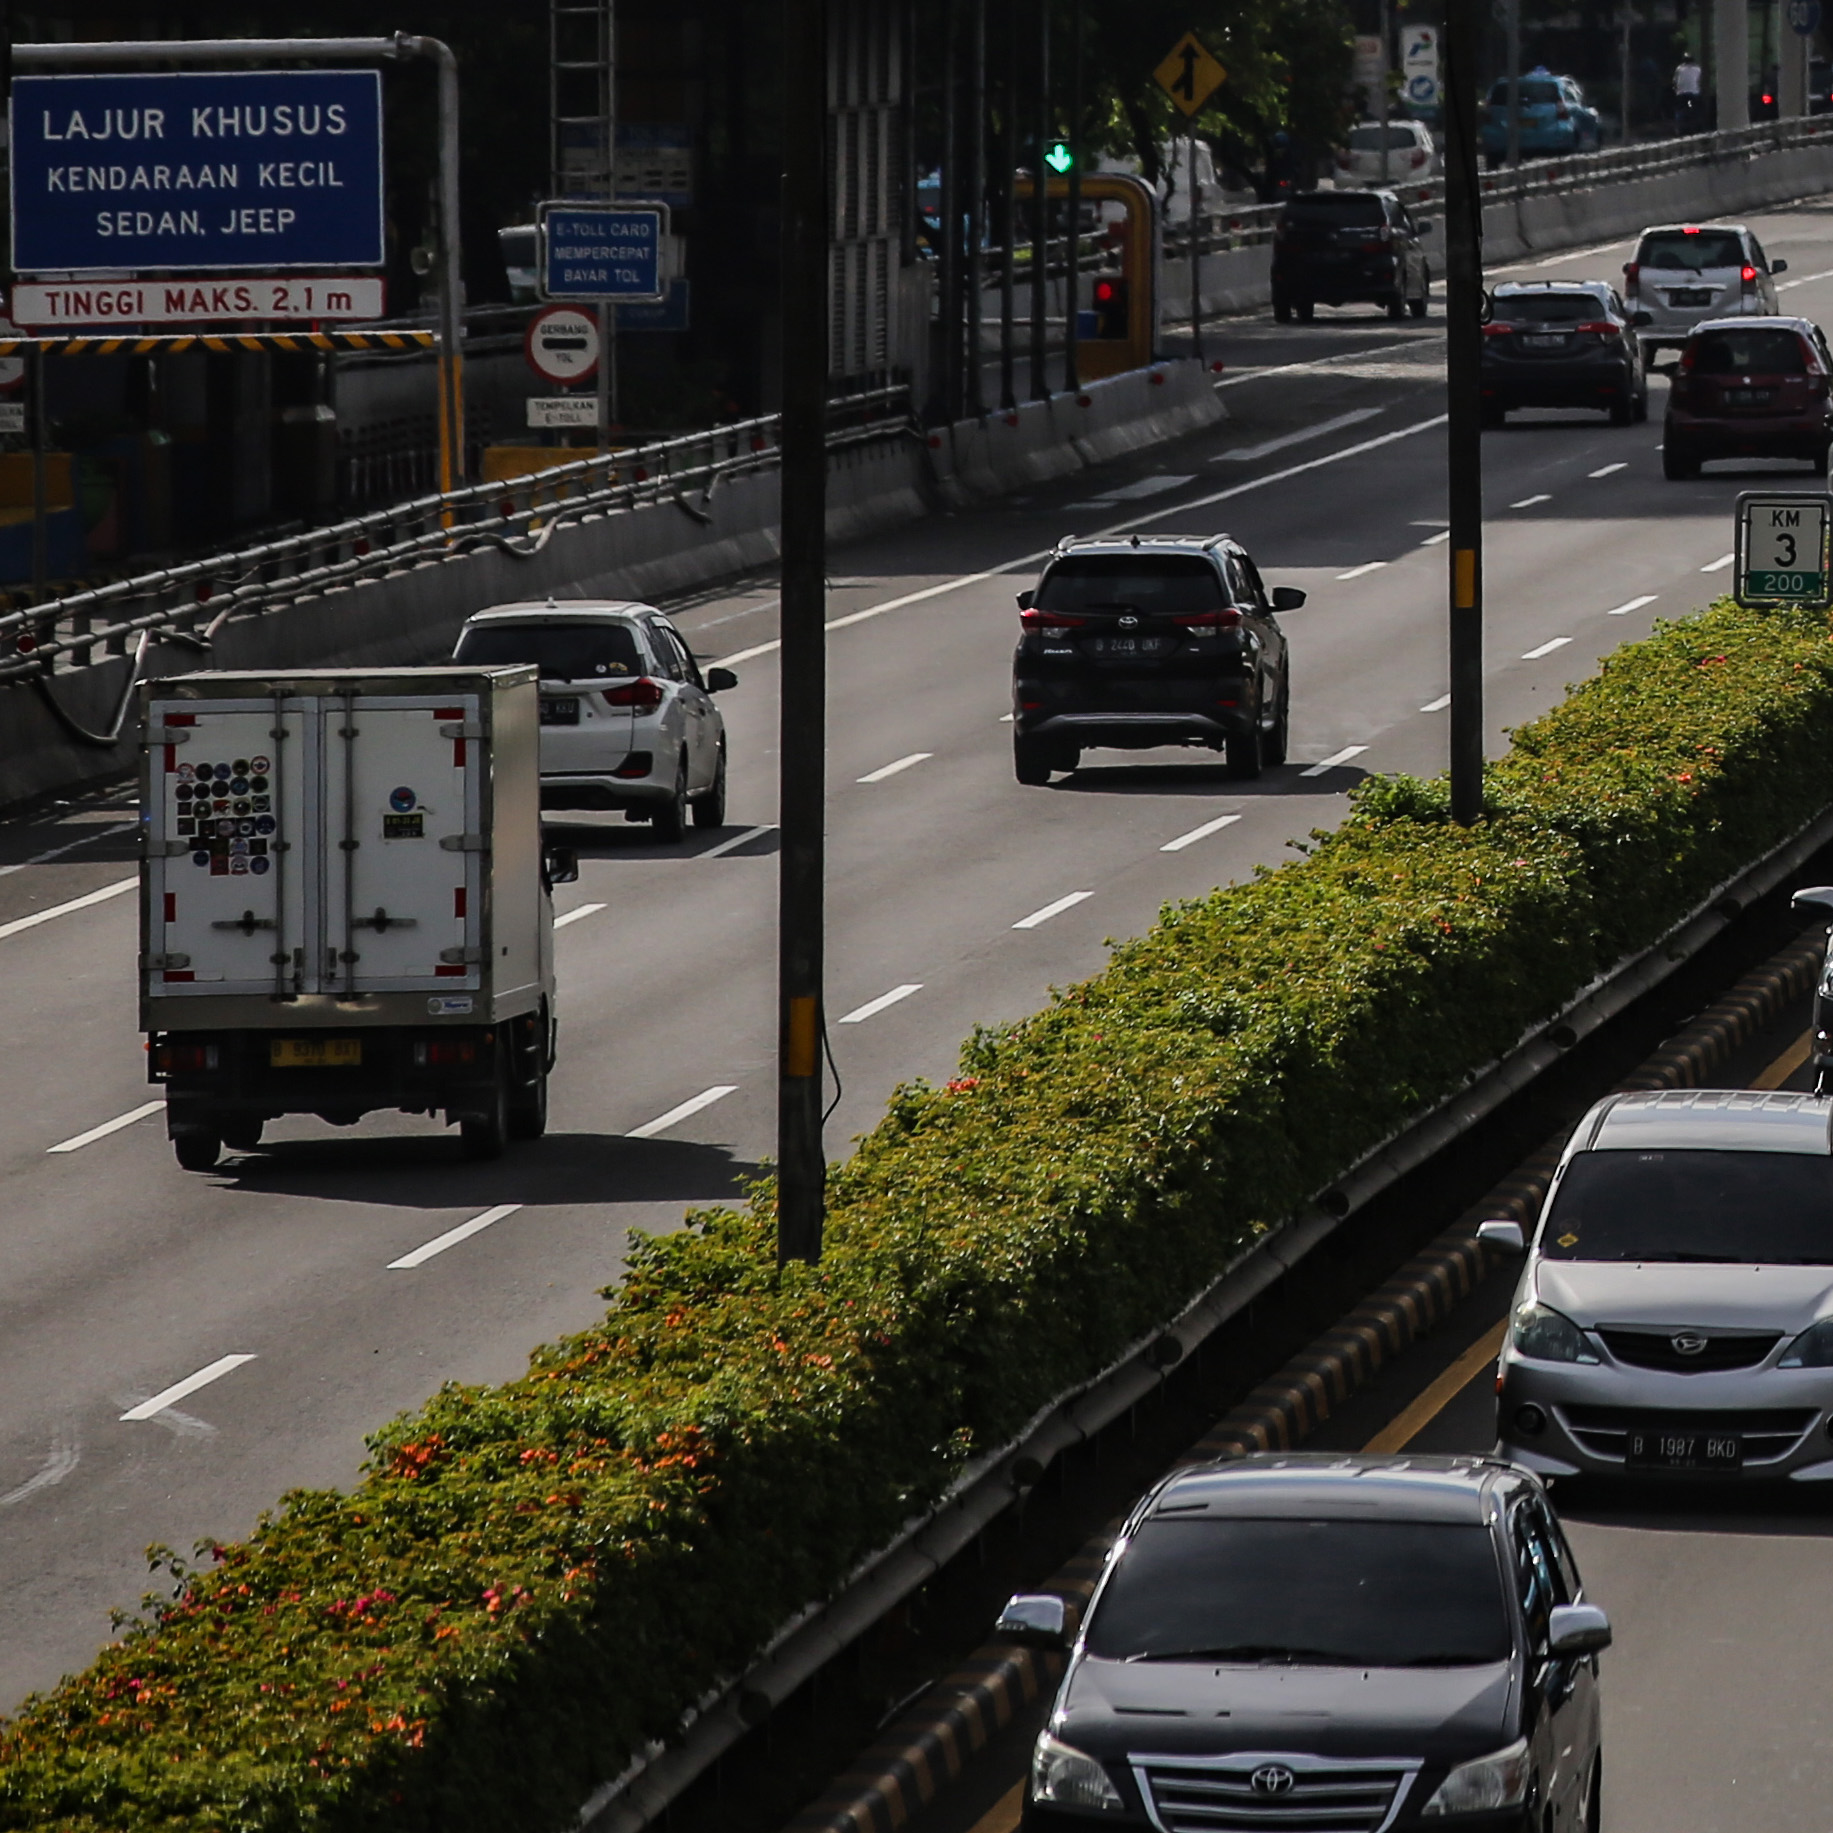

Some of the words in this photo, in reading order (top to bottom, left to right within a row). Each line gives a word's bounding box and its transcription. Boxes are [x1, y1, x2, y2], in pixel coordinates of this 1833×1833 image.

[43, 109, 165, 140] LAJUR
[191, 104, 347, 138] KHUSUS
[47, 164, 238, 192] KENDARAAN
[258, 161, 345, 187] KECIL
[219, 208, 296, 234] JEEP
[556, 223, 604, 236] E-TOLL
[610, 223, 650, 236] CARD
[554, 247, 650, 260] MEMPERCEPAT
[564, 269, 607, 283] BAYAR
[615, 270, 640, 283] TOL
[45, 290, 143, 316] TINGGI
[165, 287, 258, 313] MAKS.
[327, 292, 352, 310] m
[1772, 510, 1799, 527] KM
[1775, 533, 1797, 567] 3
[1764, 575, 1803, 592] 200
[1634, 1436, 1643, 1455] B
[1660, 1437, 1695, 1456] 1987
[1707, 1439, 1736, 1458] BKD
